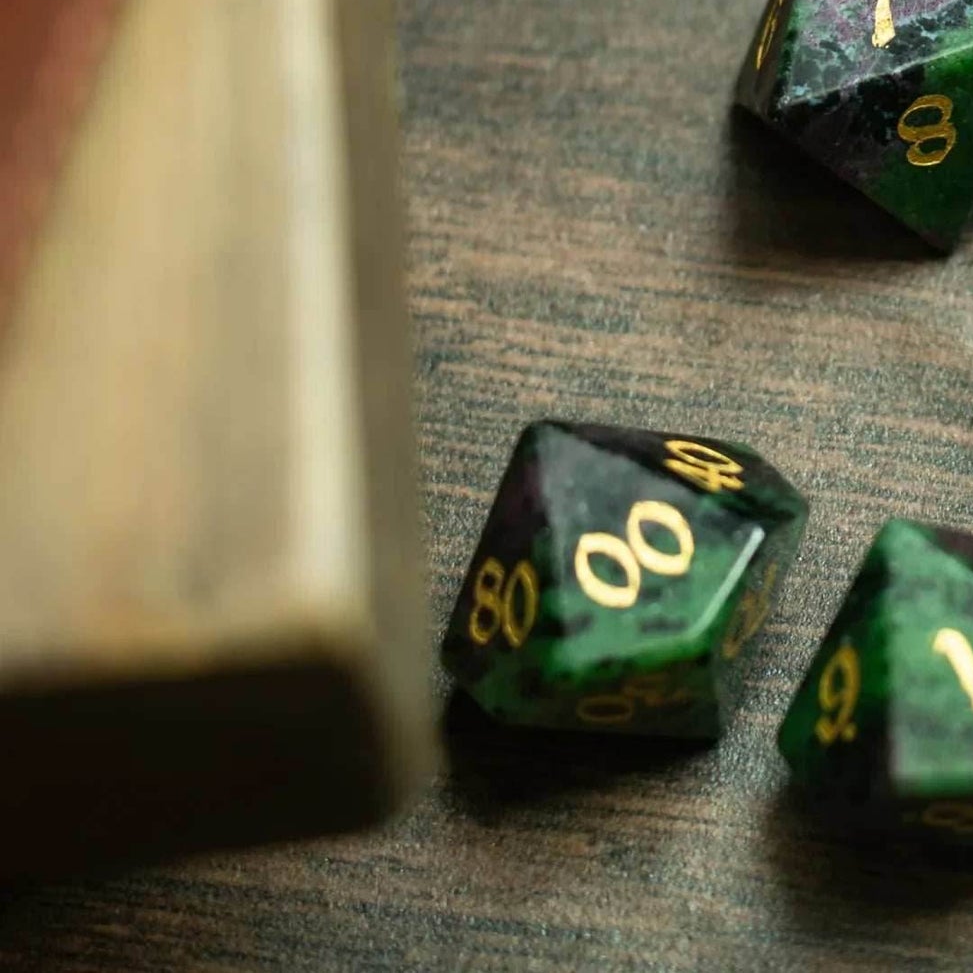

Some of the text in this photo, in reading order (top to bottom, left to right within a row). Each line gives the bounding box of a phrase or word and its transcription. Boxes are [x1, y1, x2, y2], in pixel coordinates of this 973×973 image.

[897, 94, 956, 166] 8
[662, 439, 745, 494] 40
[574, 499, 695, 609] 00
[469, 556, 540, 649] 80
